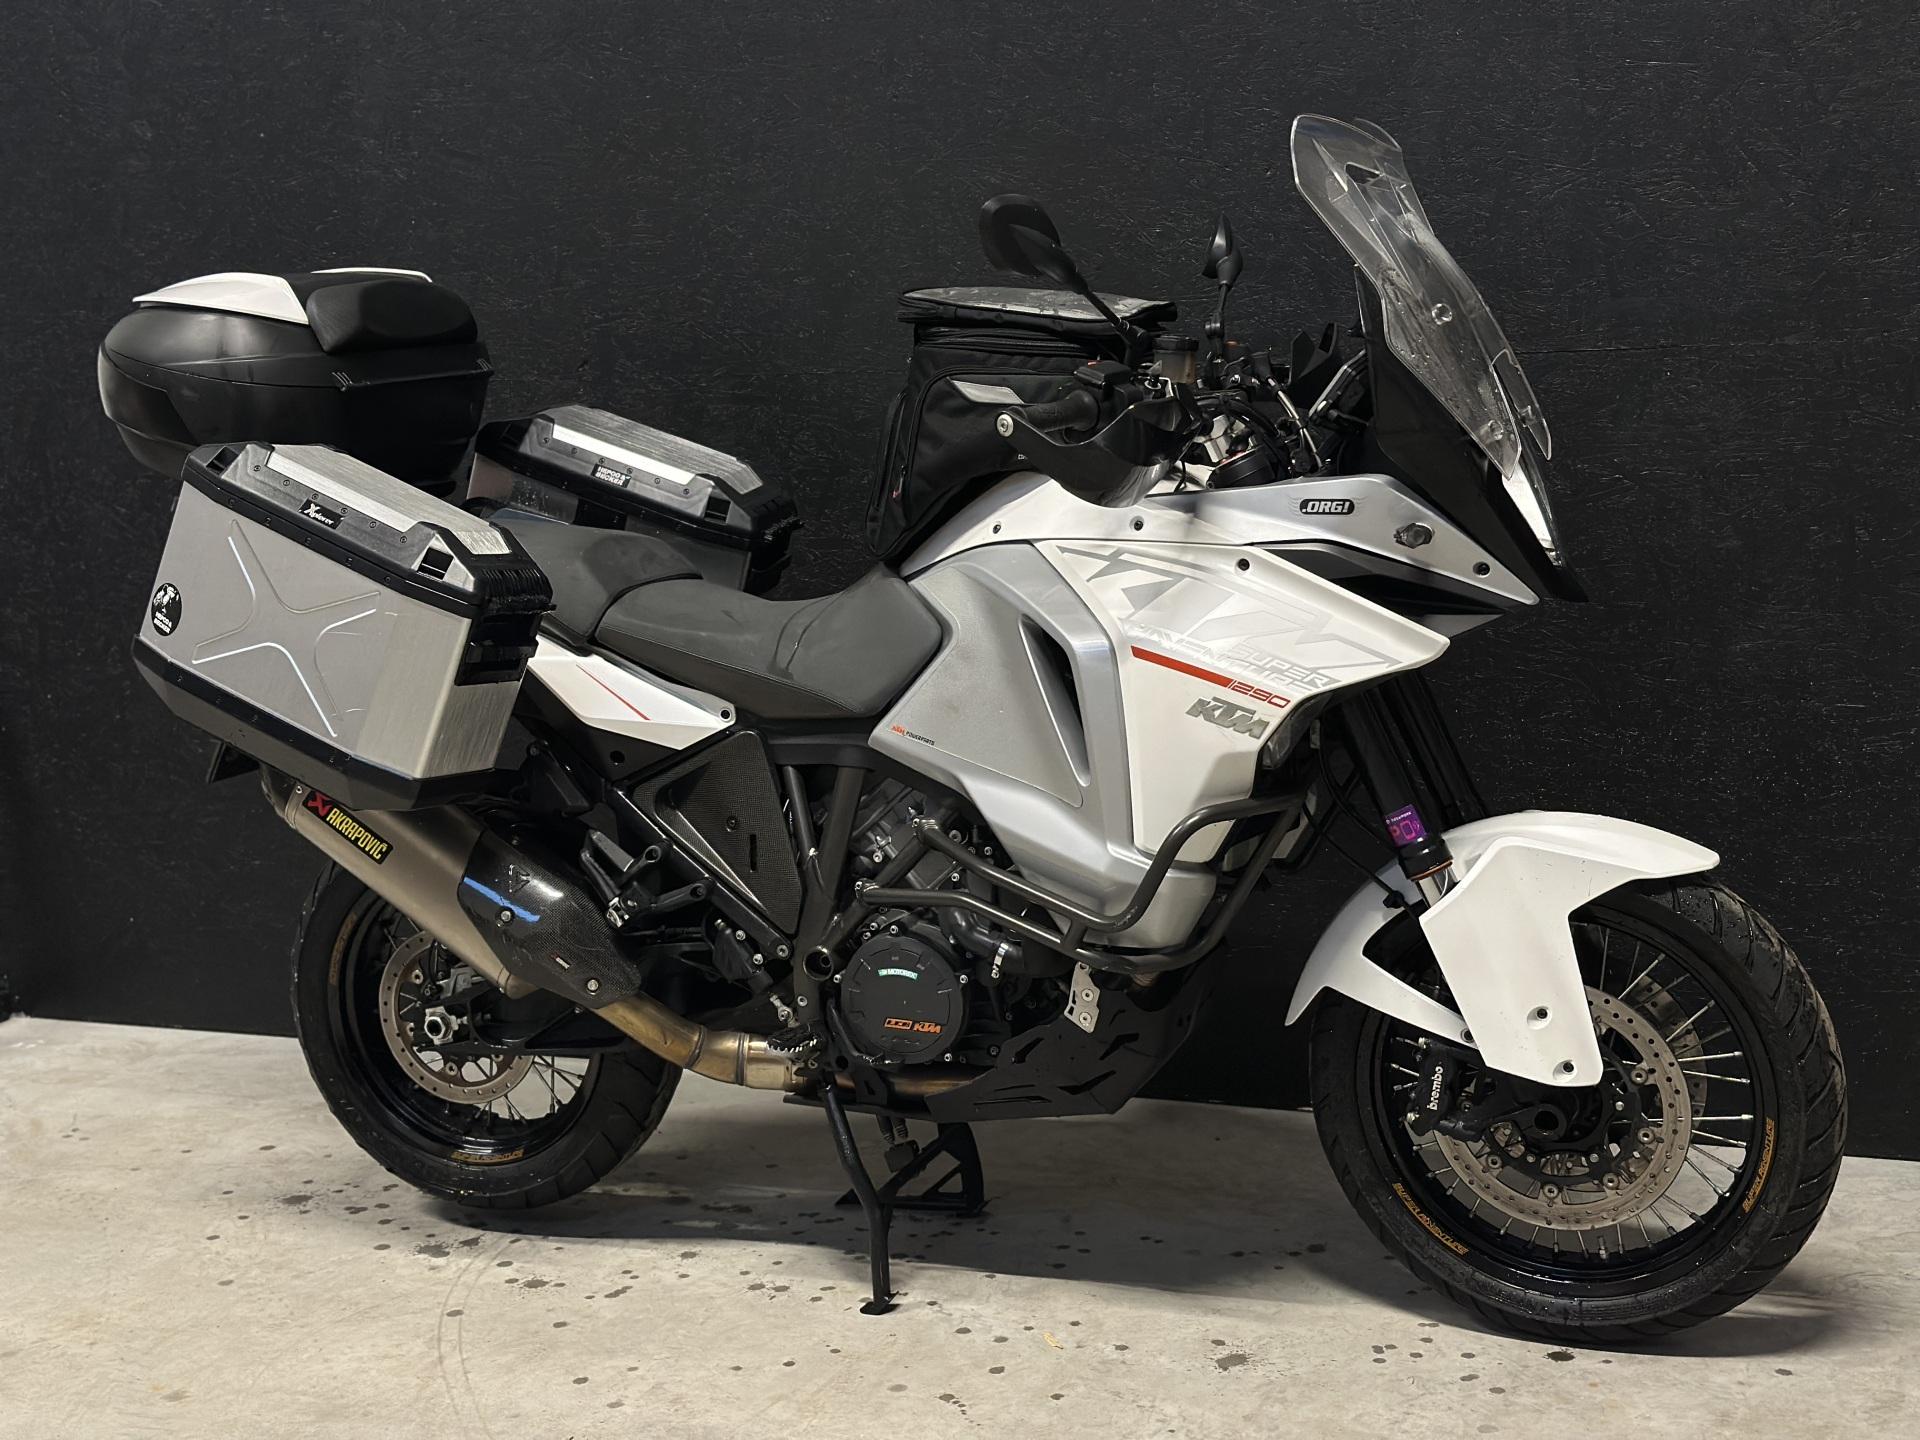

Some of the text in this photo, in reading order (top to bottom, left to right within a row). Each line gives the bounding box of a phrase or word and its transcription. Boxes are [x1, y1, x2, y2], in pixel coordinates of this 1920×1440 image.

[1228, 680, 1291, 709] 1290
[1185, 696, 1270, 740] KTM
[913, 1021, 942, 1034] KTM
[1426, 1066, 1443, 1110] brembo
